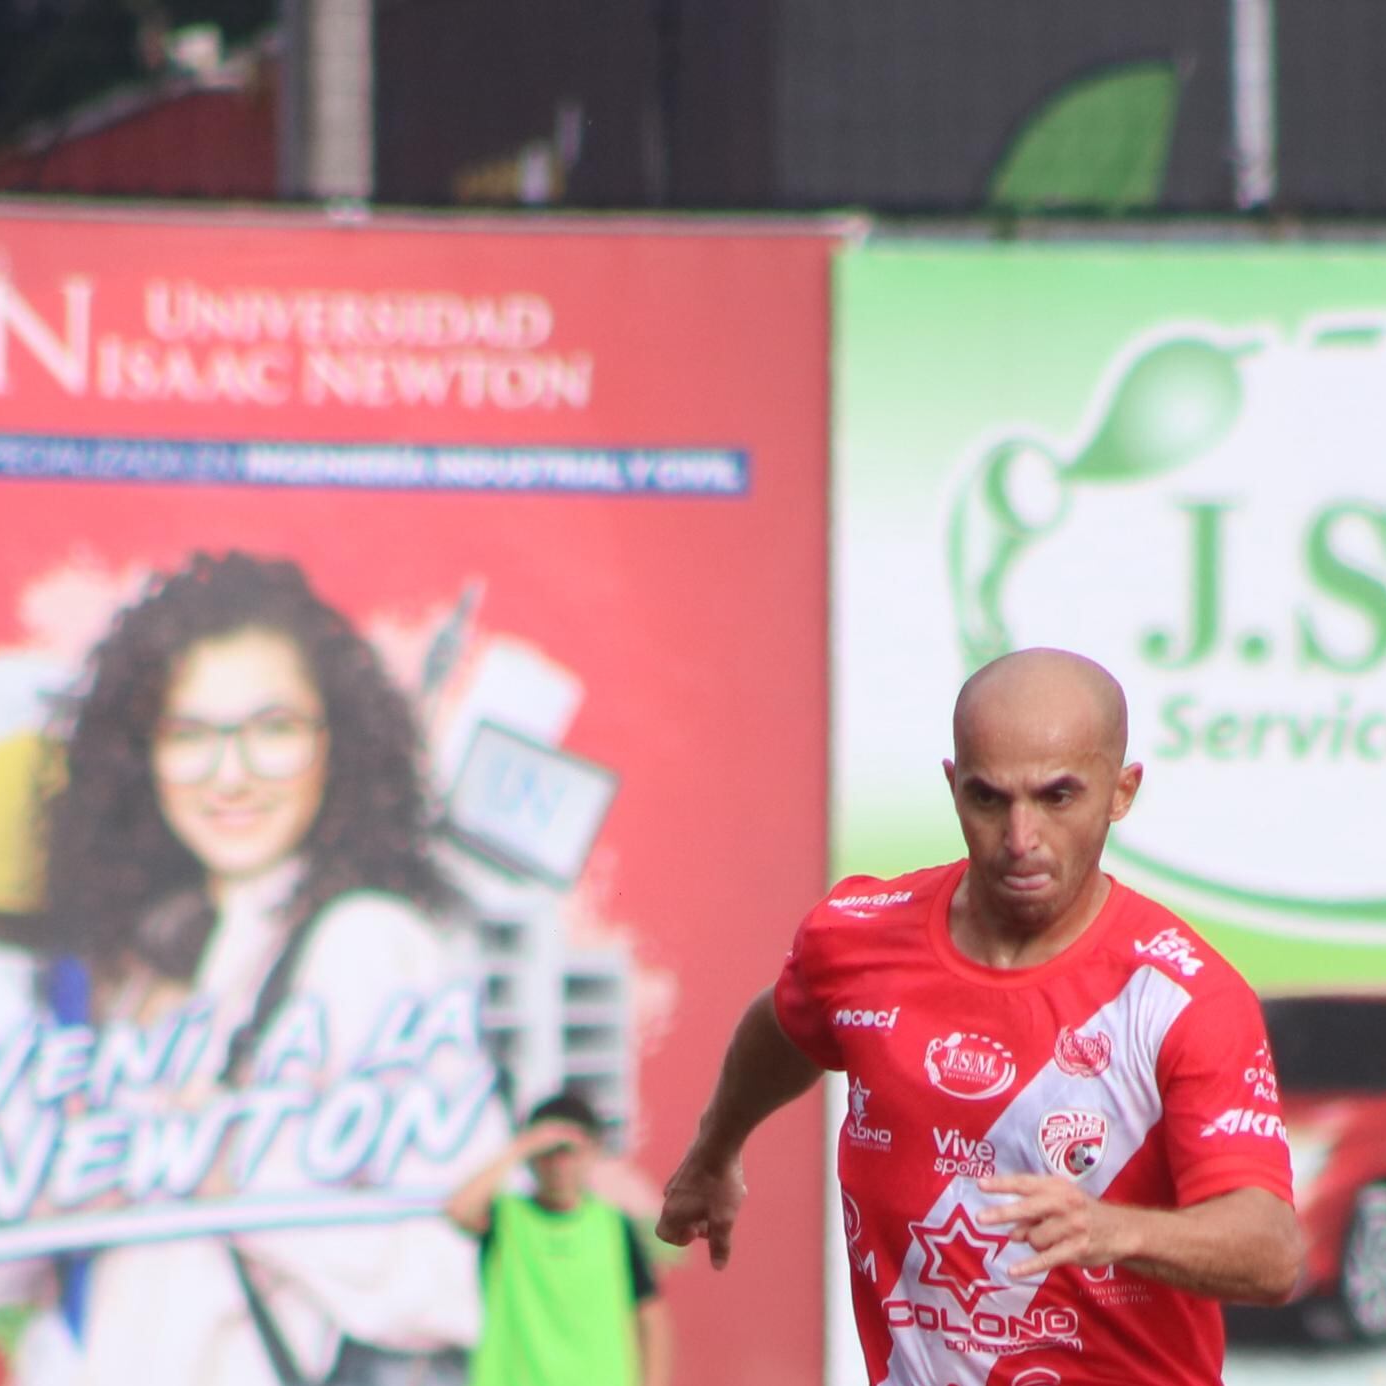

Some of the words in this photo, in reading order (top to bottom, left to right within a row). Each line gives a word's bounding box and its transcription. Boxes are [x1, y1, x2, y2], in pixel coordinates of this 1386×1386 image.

[143, 280, 554, 348] UNIVERSIDAD
[97, 341, 294, 402] ISAAC
[303, 350, 595, 410] NEWTON
[254, 992, 327, 1086] A
[349, 978, 481, 1080] LA
[932, 1127, 995, 1161] Vive
[1200, 1108, 1290, 1144] AKR
[933, 1157, 995, 1178] sports
[882, 1300, 1078, 1338] COLONO
